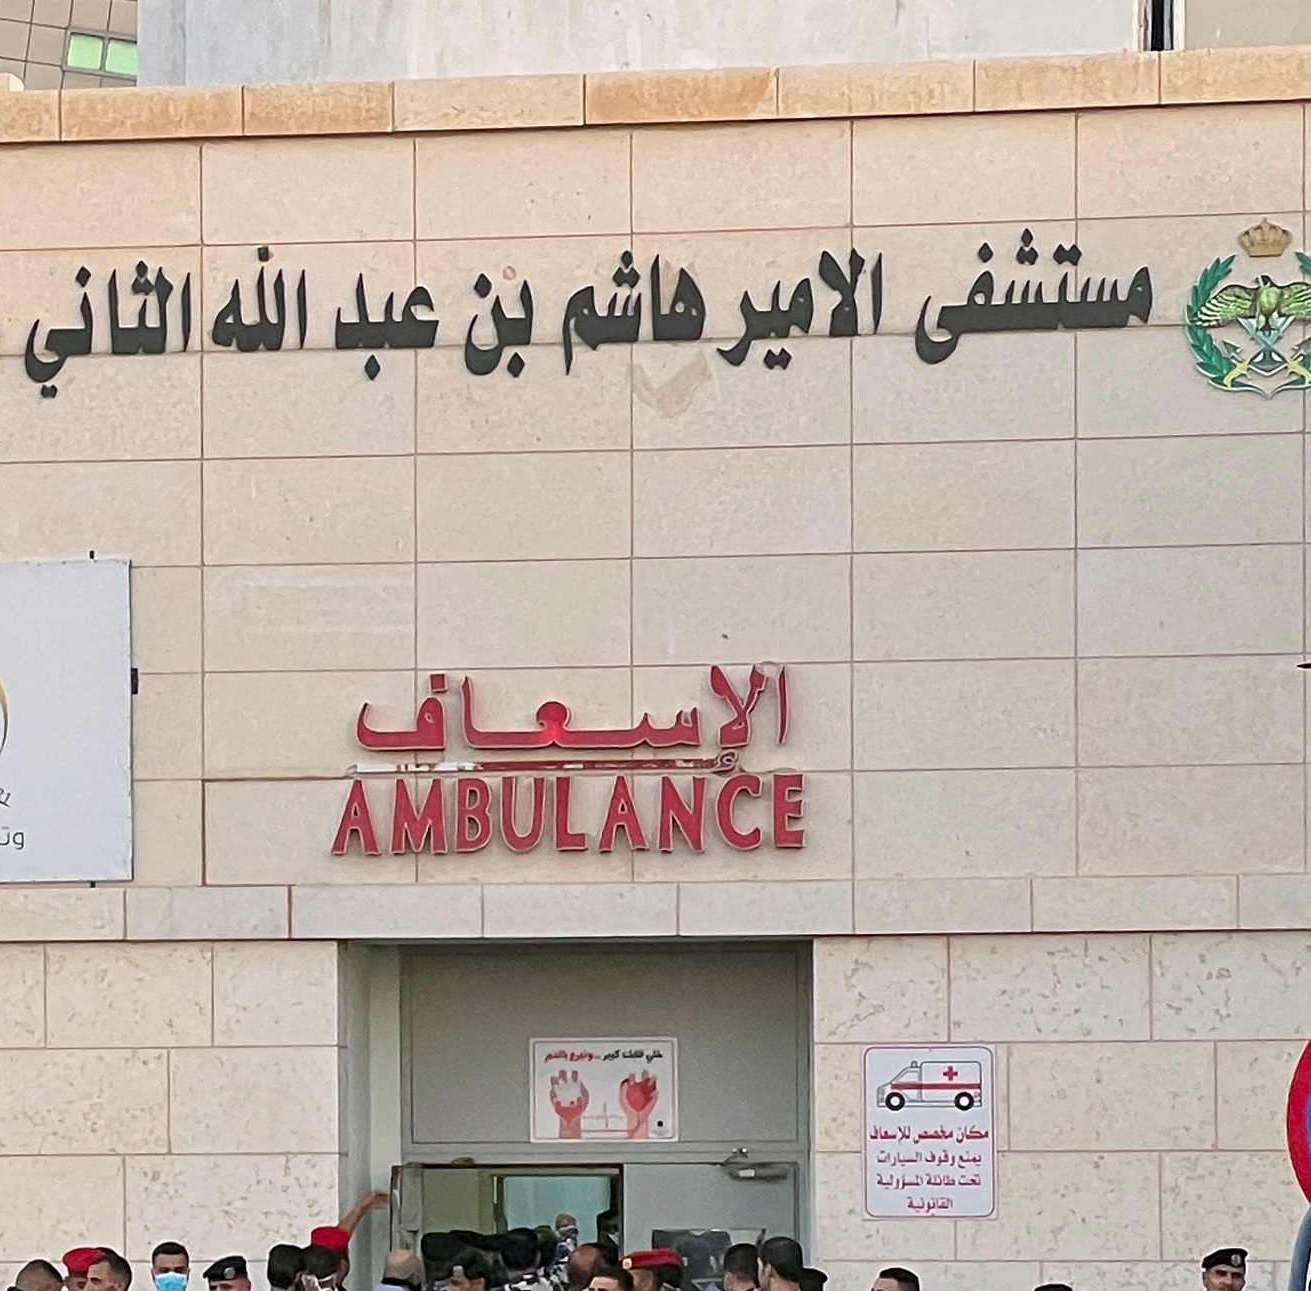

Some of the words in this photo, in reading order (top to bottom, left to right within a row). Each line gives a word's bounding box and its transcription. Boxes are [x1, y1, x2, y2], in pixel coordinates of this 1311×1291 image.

[22, 261, 193, 399] الثاني
[211, 246, 308, 354] الله
[335, 272, 440, 381] عبد
[465, 273, 534, 378] بن
[563, 251, 706, 376] هاشم
[717, 248, 883, 370] الامير
[915, 229, 1153, 365] مستشفى
[331, 773, 805, 856] AMBULANCE
[877, 1150, 923, 1167] السيارات
[913, 1125, 954, 1145] مخصص
[924, 1149, 955, 1167] وقوف
[956, 1125, 989, 1144] مكان
[957, 1150, 982, 1169] يمنع
[906, 1195, 954, 1213] القانونية
[958, 1173, 982, 1187] تحت
